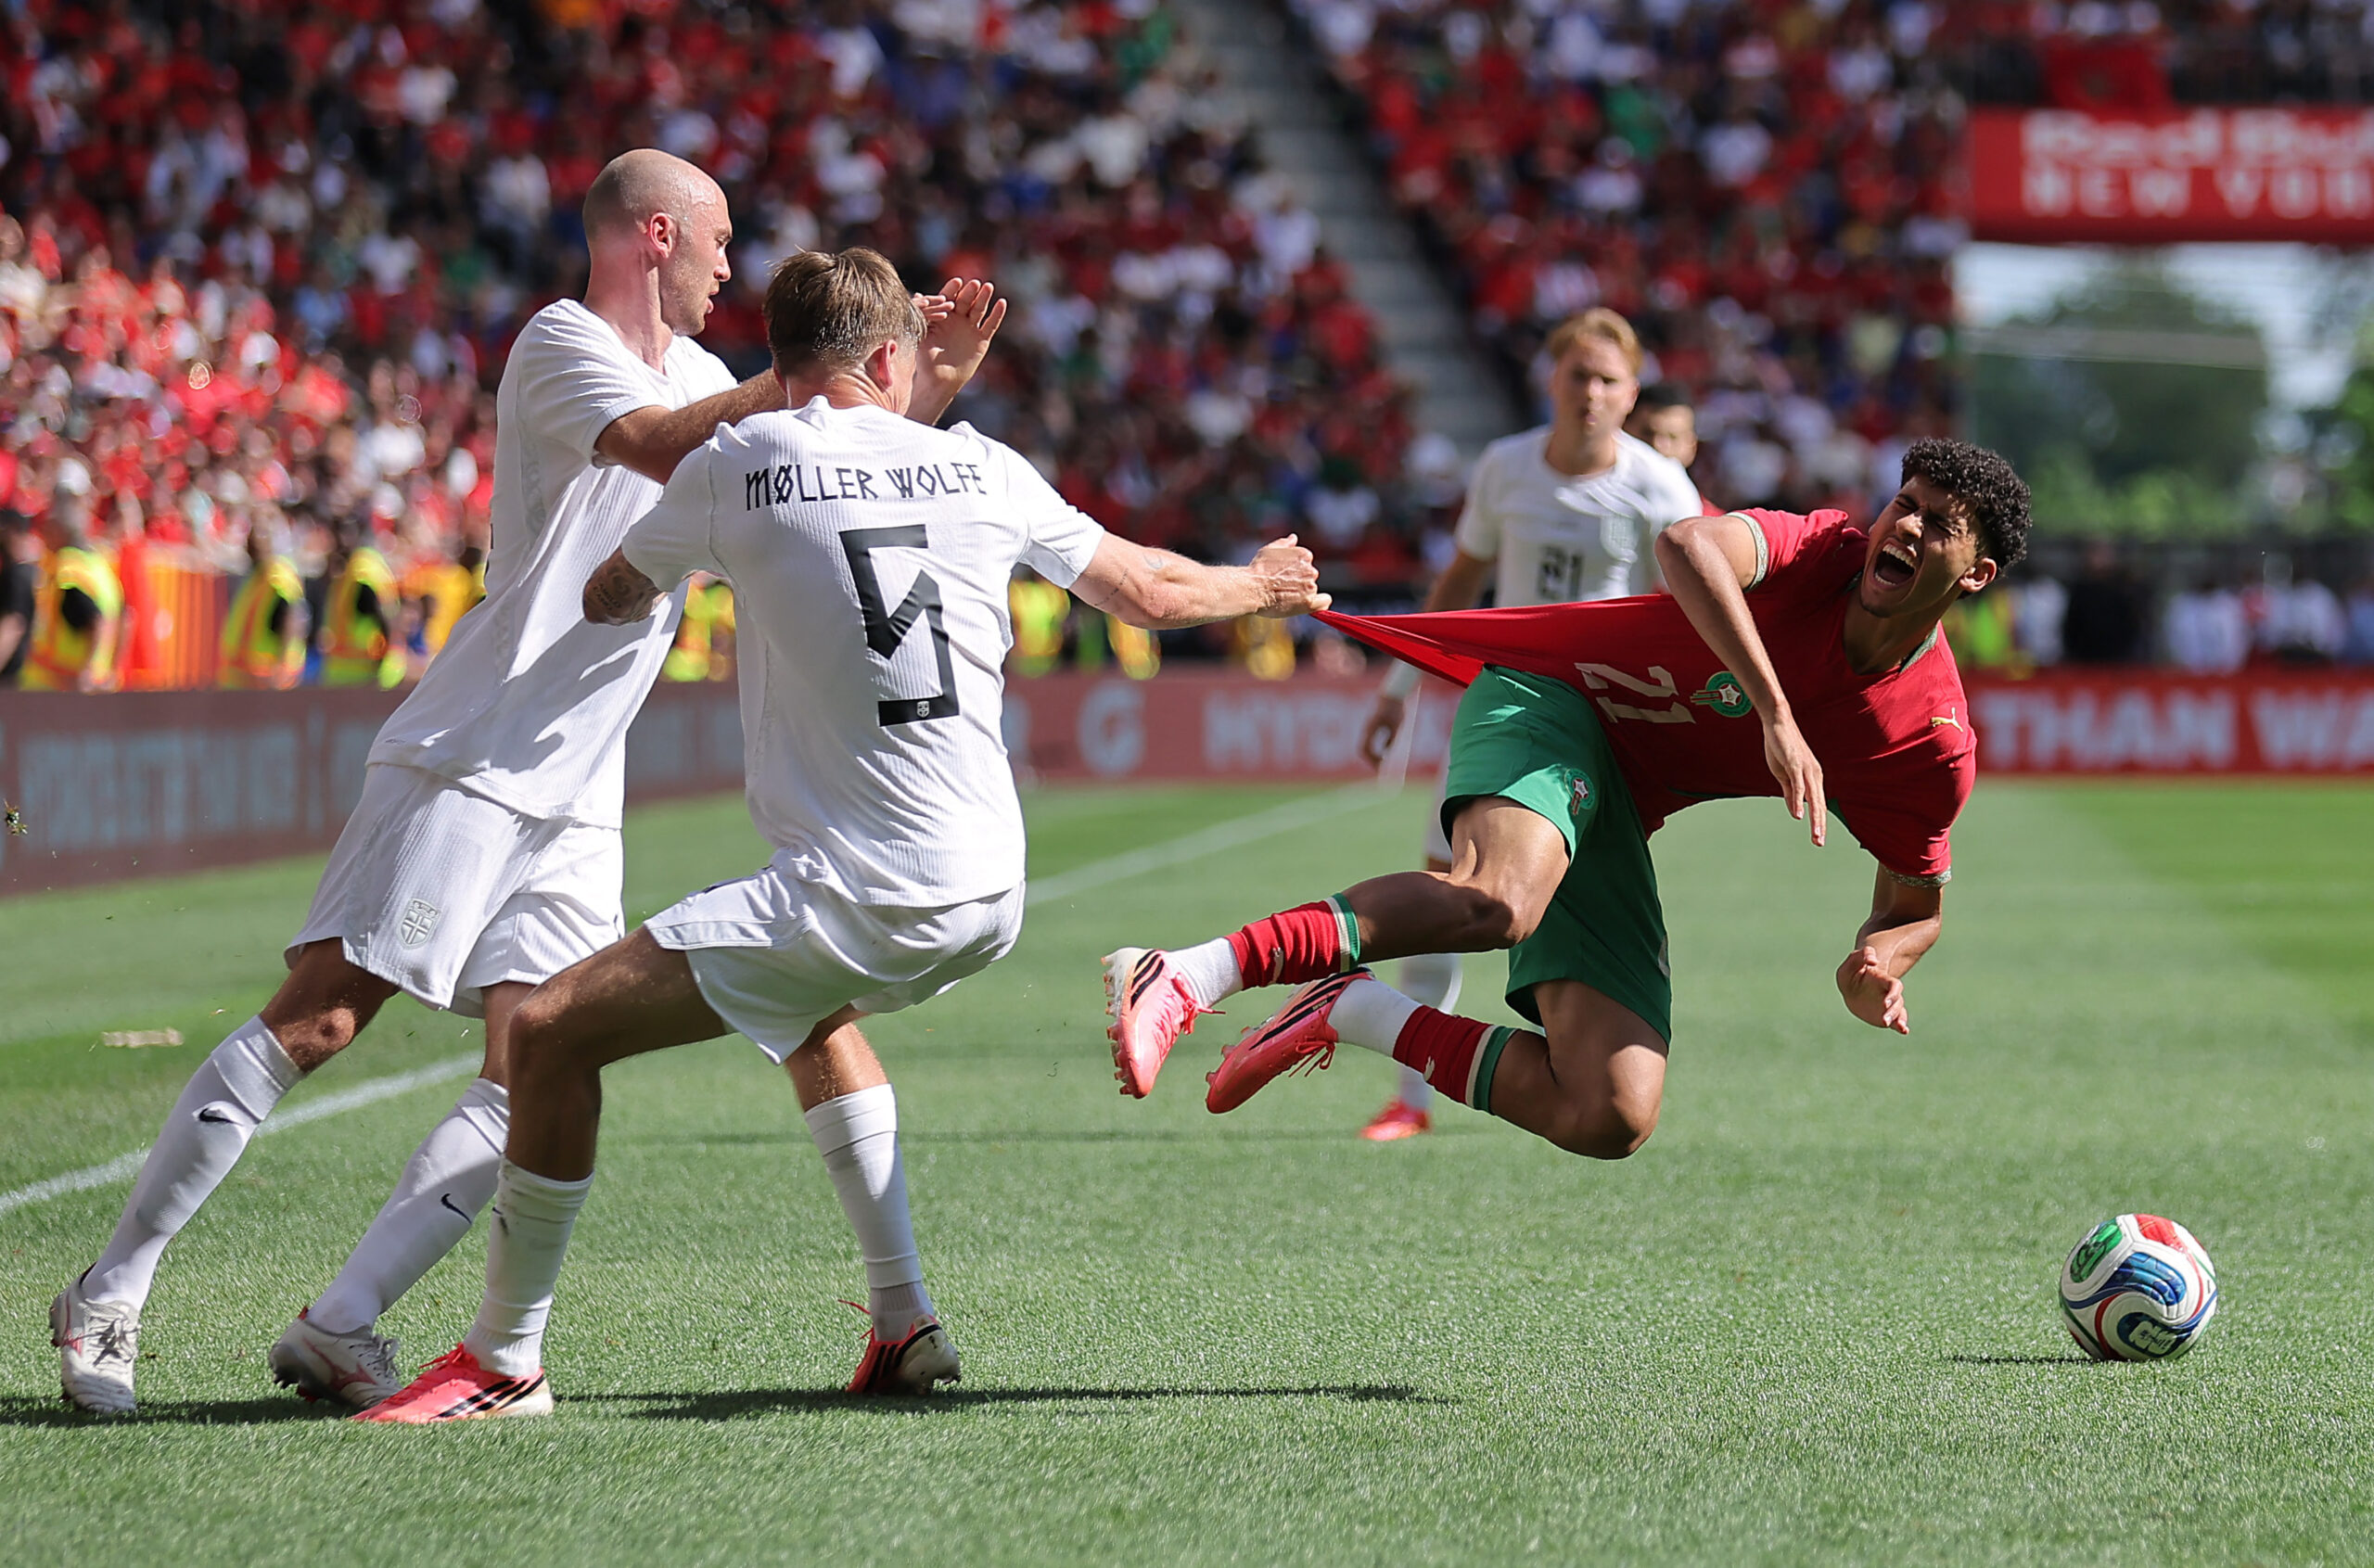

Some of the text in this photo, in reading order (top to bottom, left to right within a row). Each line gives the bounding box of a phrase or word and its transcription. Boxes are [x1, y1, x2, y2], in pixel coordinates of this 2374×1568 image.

[2022, 108, 2223, 168] Red
[2022, 167, 2190, 217] NEW
[745, 462, 987, 511] MØLLER WOLFE
[838, 524, 960, 727] 5
[1574, 662, 1696, 724] 21
[1078, 680, 1145, 777] G
[1980, 688, 2237, 770] THAN
